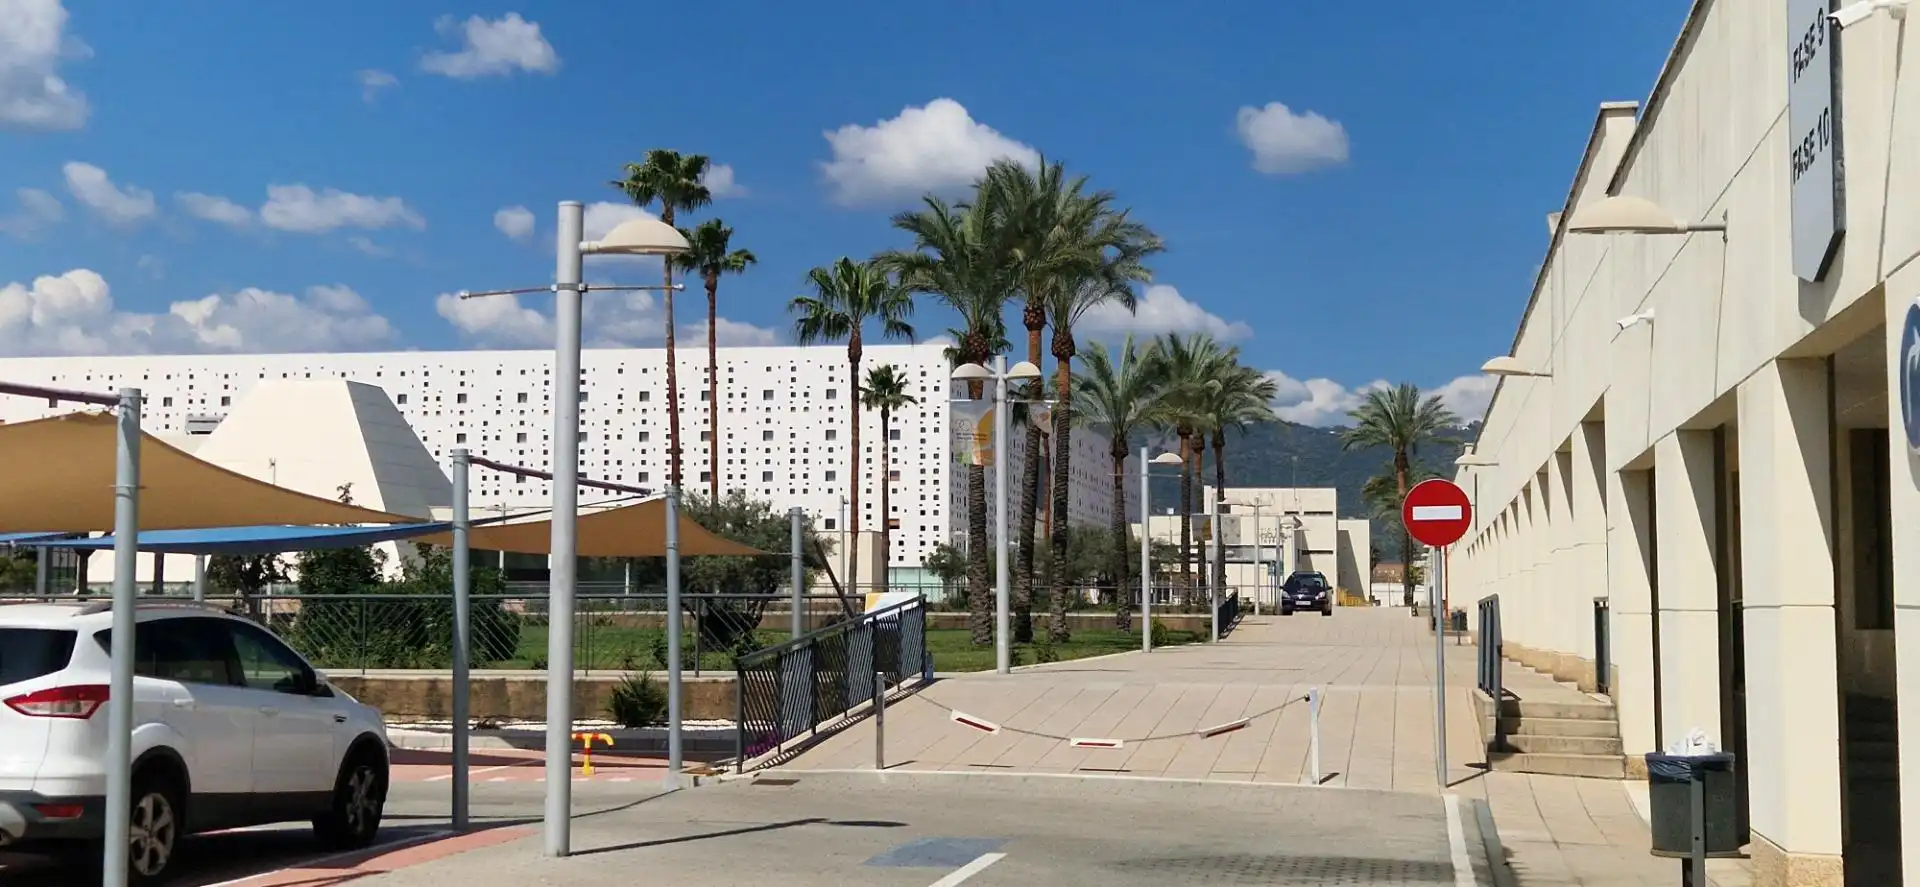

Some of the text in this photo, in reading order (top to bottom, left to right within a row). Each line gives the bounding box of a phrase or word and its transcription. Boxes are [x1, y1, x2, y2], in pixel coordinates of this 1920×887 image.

[1793, 7, 1824, 84] FASE 9
[1792, 106, 1830, 185] FASE 10
